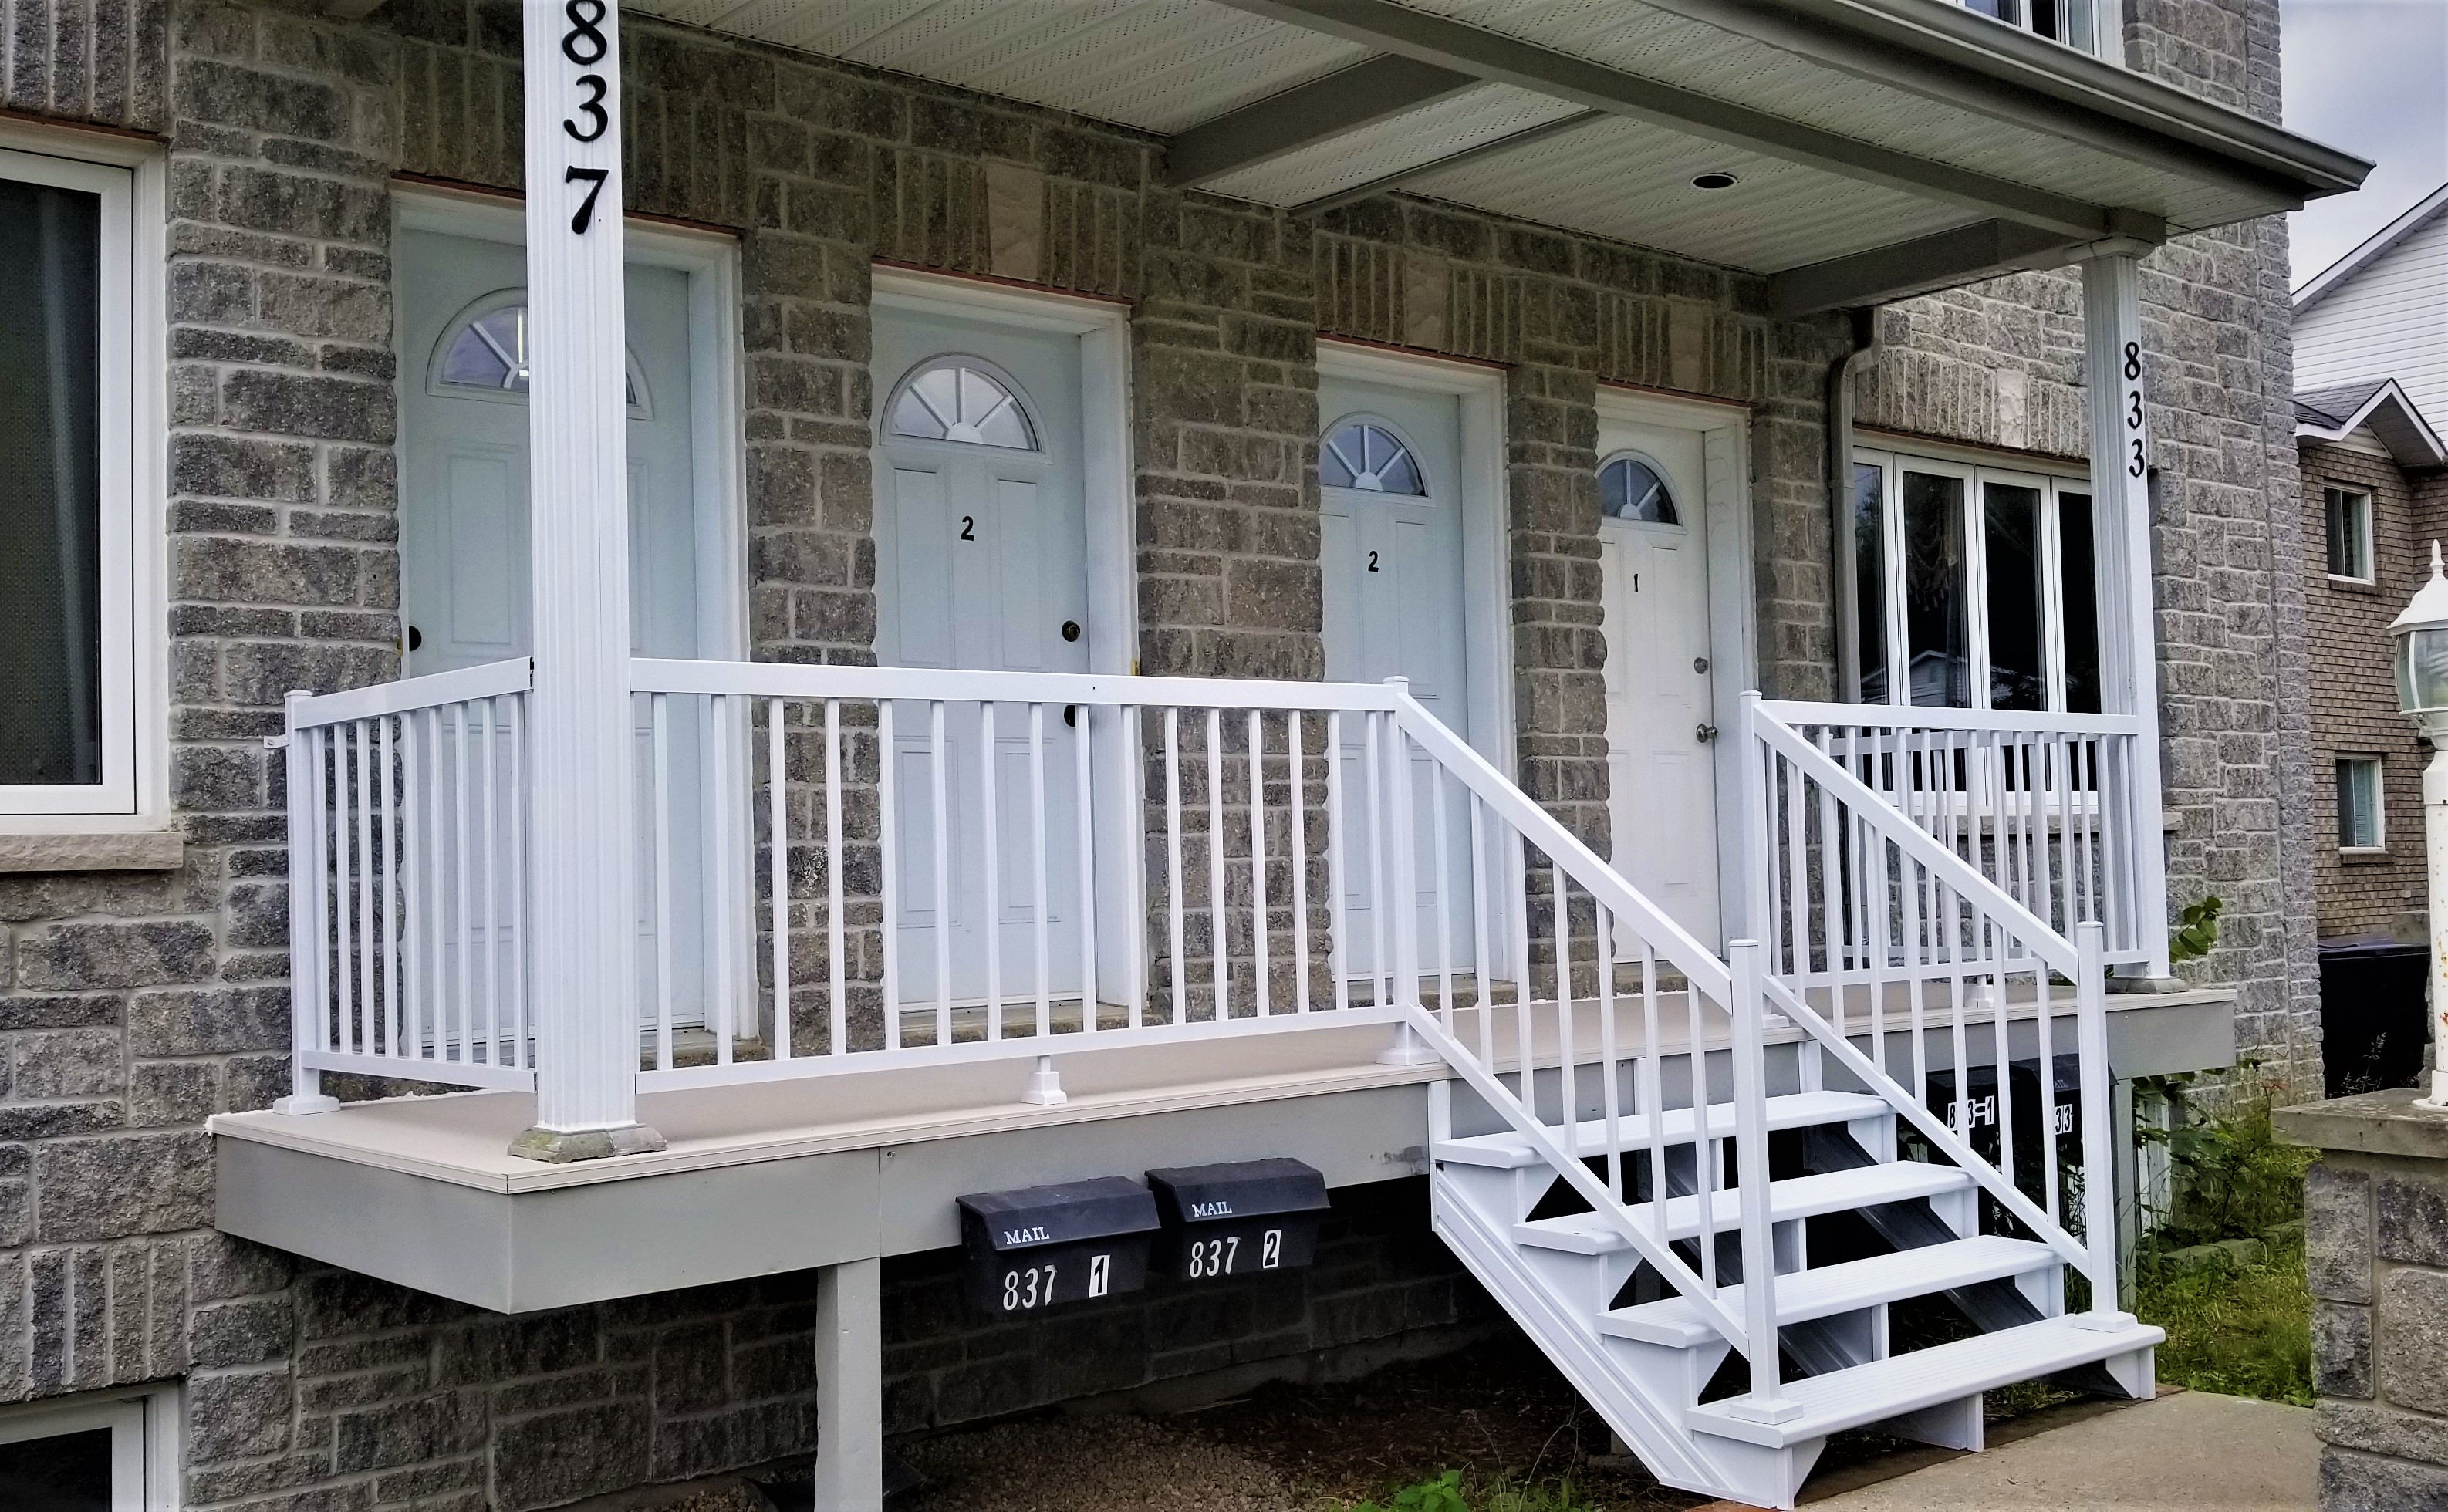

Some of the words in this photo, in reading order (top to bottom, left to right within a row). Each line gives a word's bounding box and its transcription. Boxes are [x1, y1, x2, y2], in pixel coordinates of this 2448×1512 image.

[562, 0, 609, 235] 837
[2124, 341, 2145, 478] 833
[960, 515, 975, 542] 2
[1367, 550, 1379, 573] 2
[1633, 573, 1639, 593] 1
[2055, 1105, 2072, 1134] 33
[1192, 1201, 1233, 1217] MAIL
[1004, 1226, 1050, 1245] MAIL
[1189, 1236, 1241, 1278] 837
[1264, 1231, 1278, 1267] 2
[1003, 1264, 1057, 1311] 837
[1092, 1256, 1106, 1295] 1
